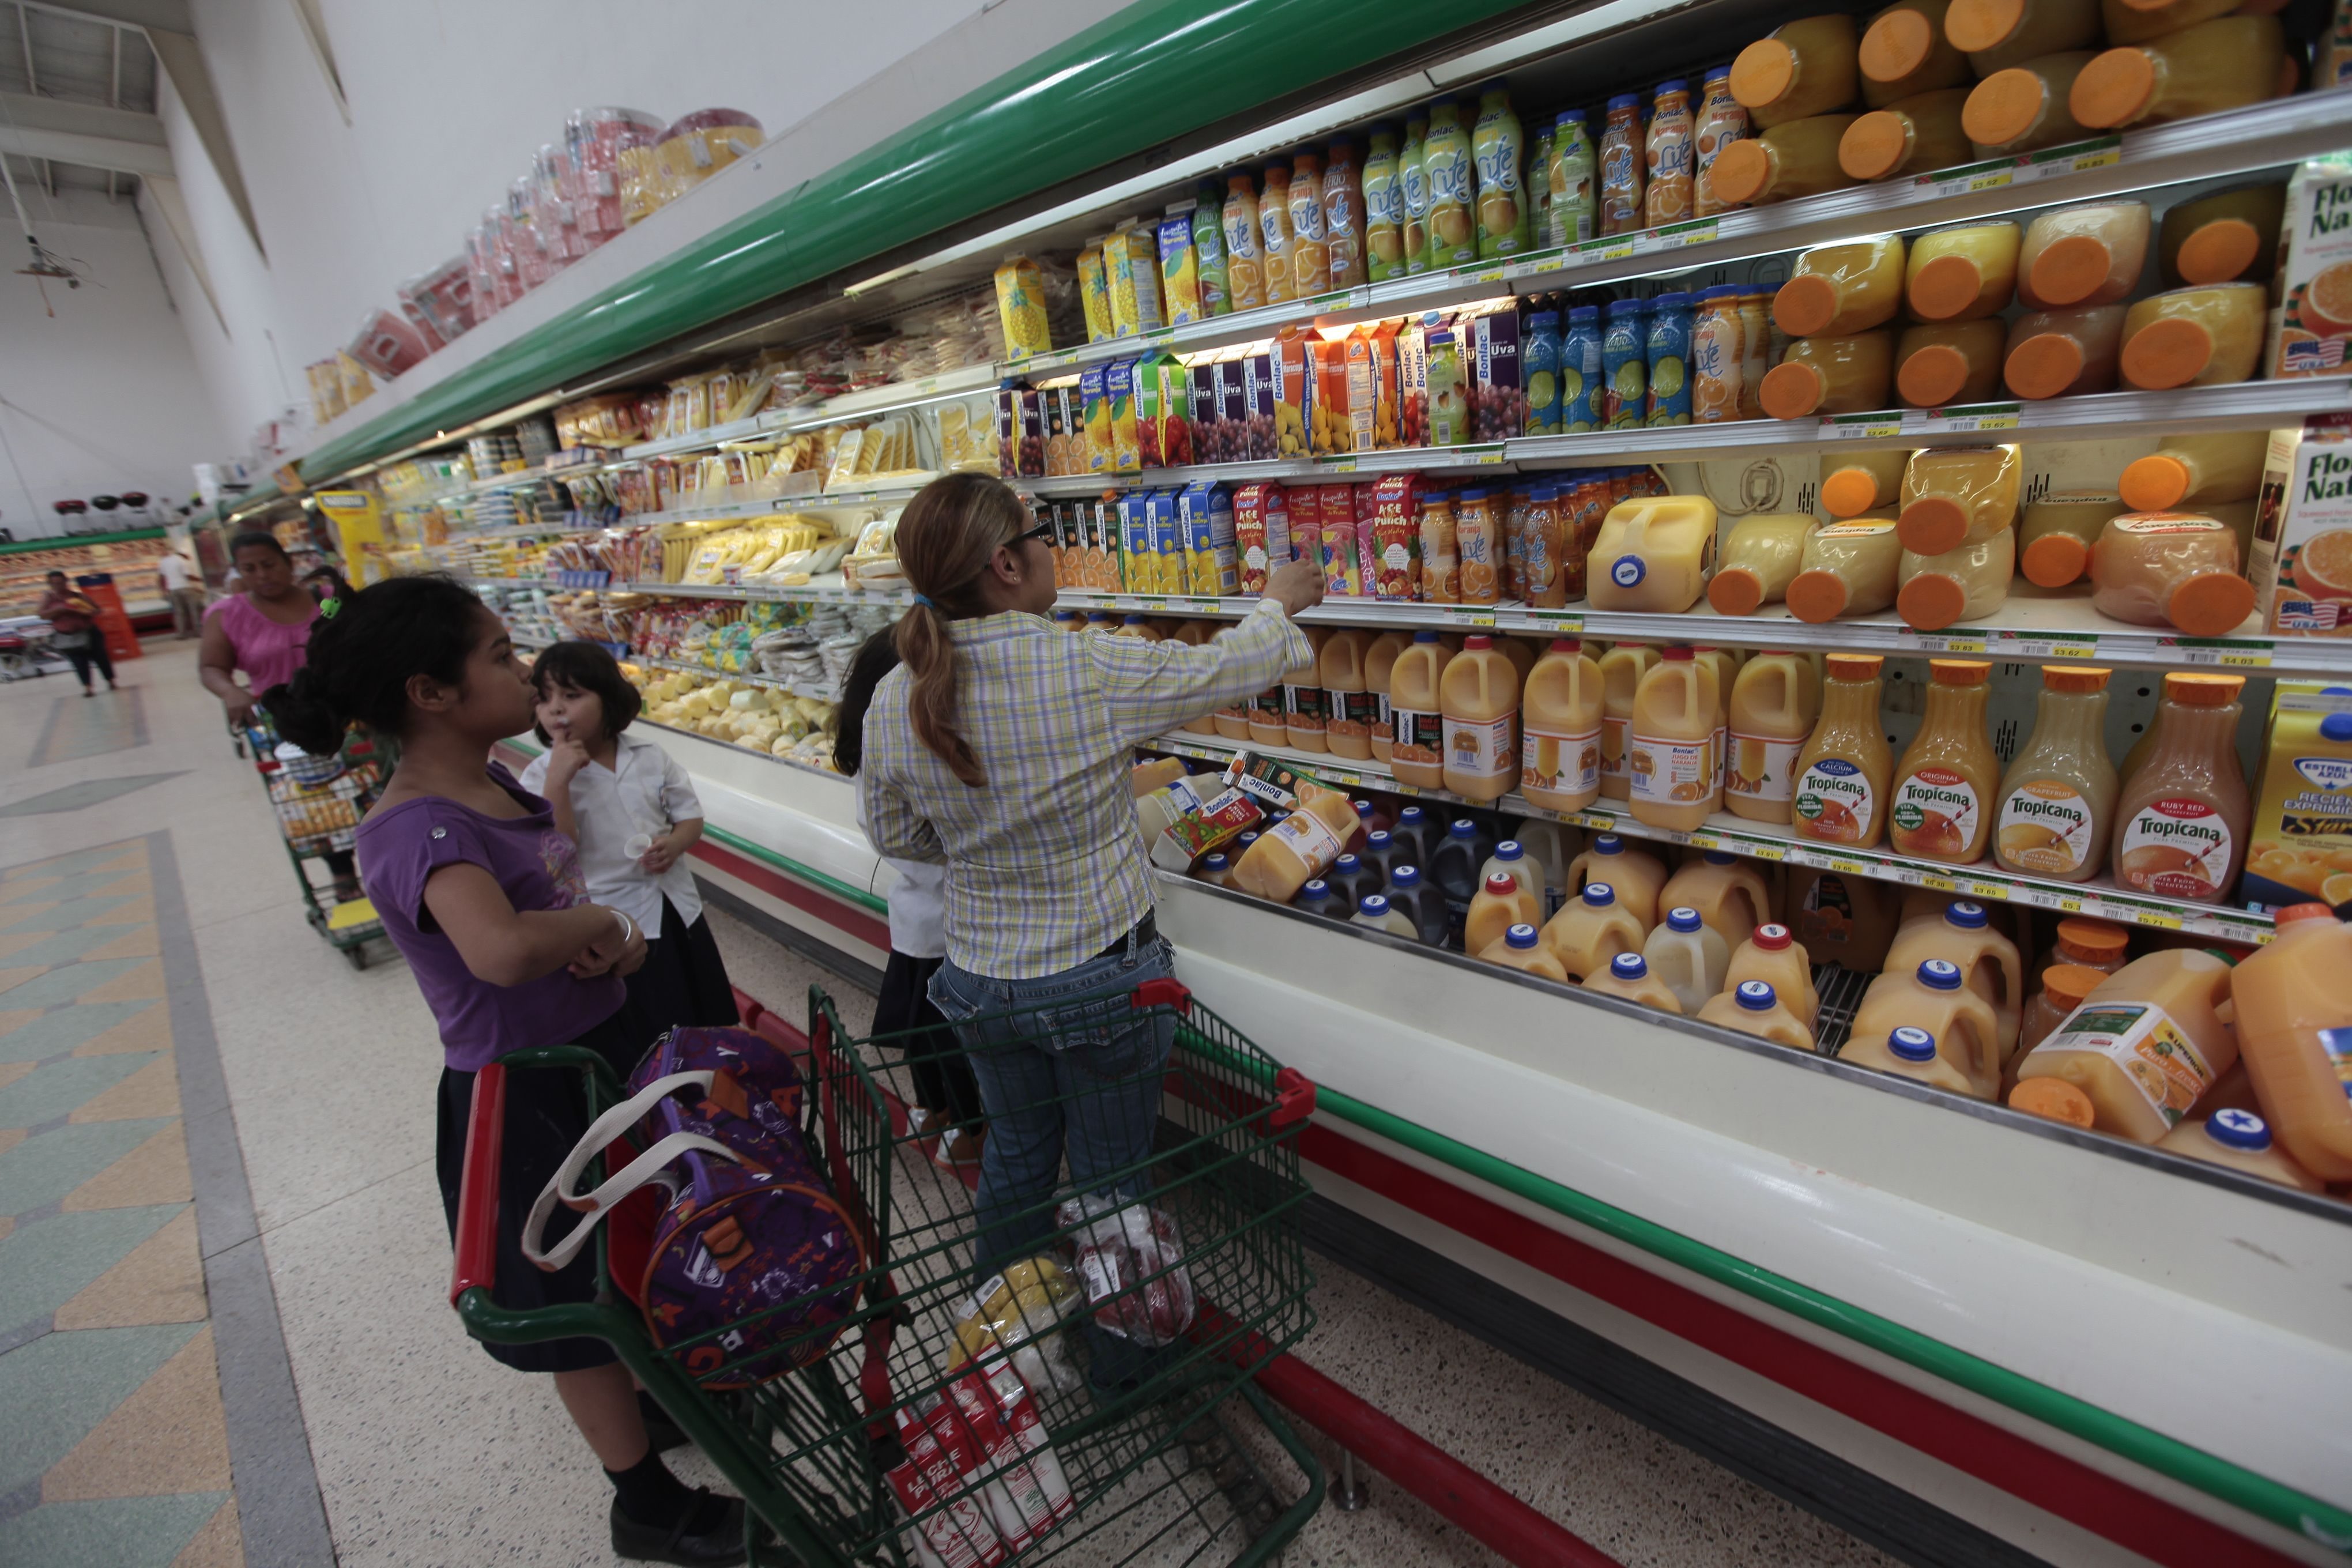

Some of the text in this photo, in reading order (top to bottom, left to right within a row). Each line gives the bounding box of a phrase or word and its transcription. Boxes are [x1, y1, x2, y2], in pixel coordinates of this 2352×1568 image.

[1491, 344, 1516, 355] Uva
[1479, 334, 1489, 379] Bonlac
[1415, 347, 1424, 388] Bonlac
[2298, 360, 2324, 370] USA
[1224, 386, 1241, 394] Uva
[1257, 380, 1272, 389] Uva
[1196, 389, 1211, 398] Uva
[1236, 520, 1262, 532] Punch
[1374, 515, 1407, 527] Punch
[2292, 620, 2320, 629] USA
[1820, 763, 1853, 772] CALCIUM
[1920, 771, 1959, 782] ORIGINAL
[2317, 770, 2349, 780] AZUL
[1249, 779, 1283, 799] Bonlac
[1806, 775, 1865, 796] Tropicana
[1905, 784, 1970, 806] Tropicana
[2026, 786, 2072, 798] GRAPEFRUIT
[1206, 796, 1234, 813] Bonlac
[2011, 797, 2083, 822] Tropicana
[2161, 800, 2206, 812] RUBY RED
[2164, 809, 2199, 817] GRAPEFRUIT
[2138, 817, 2221, 842] Tropicana
[2171, 838, 2200, 846] PREMIUM
[2174, 877, 2196, 885] FROM
[2102, 895, 2136, 907] SUPERIOR
[2140, 900, 2160, 910] JUGO
[2140, 1046, 2168, 1066] Puro
[2165, 1030, 2204, 1077] SUPERIOR
